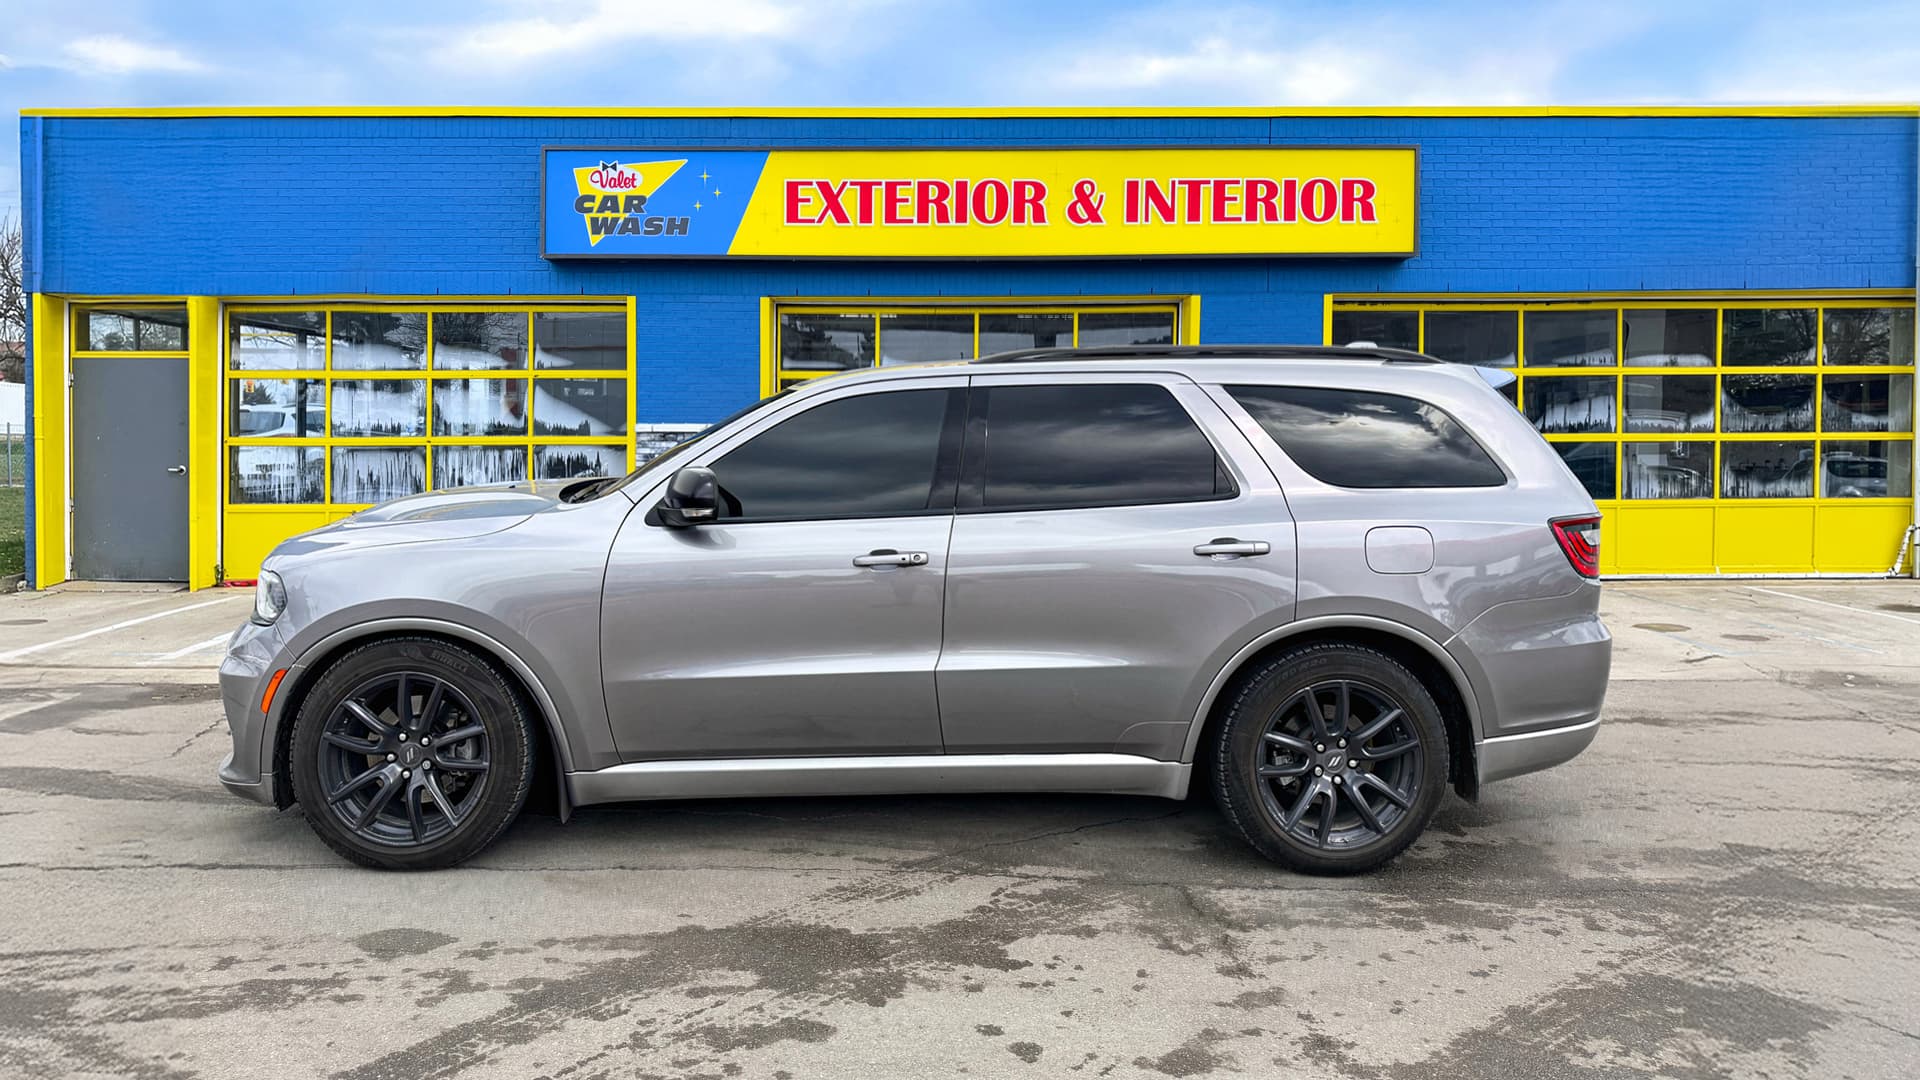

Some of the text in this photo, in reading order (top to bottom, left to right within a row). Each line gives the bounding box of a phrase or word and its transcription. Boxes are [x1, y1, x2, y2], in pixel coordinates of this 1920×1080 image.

[591, 170, 636, 188] Valet
[575, 195, 646, 213] CAR
[787, 179, 1375, 224] EXTERIOR & INTERIOR
[591, 217, 688, 235] WASH
